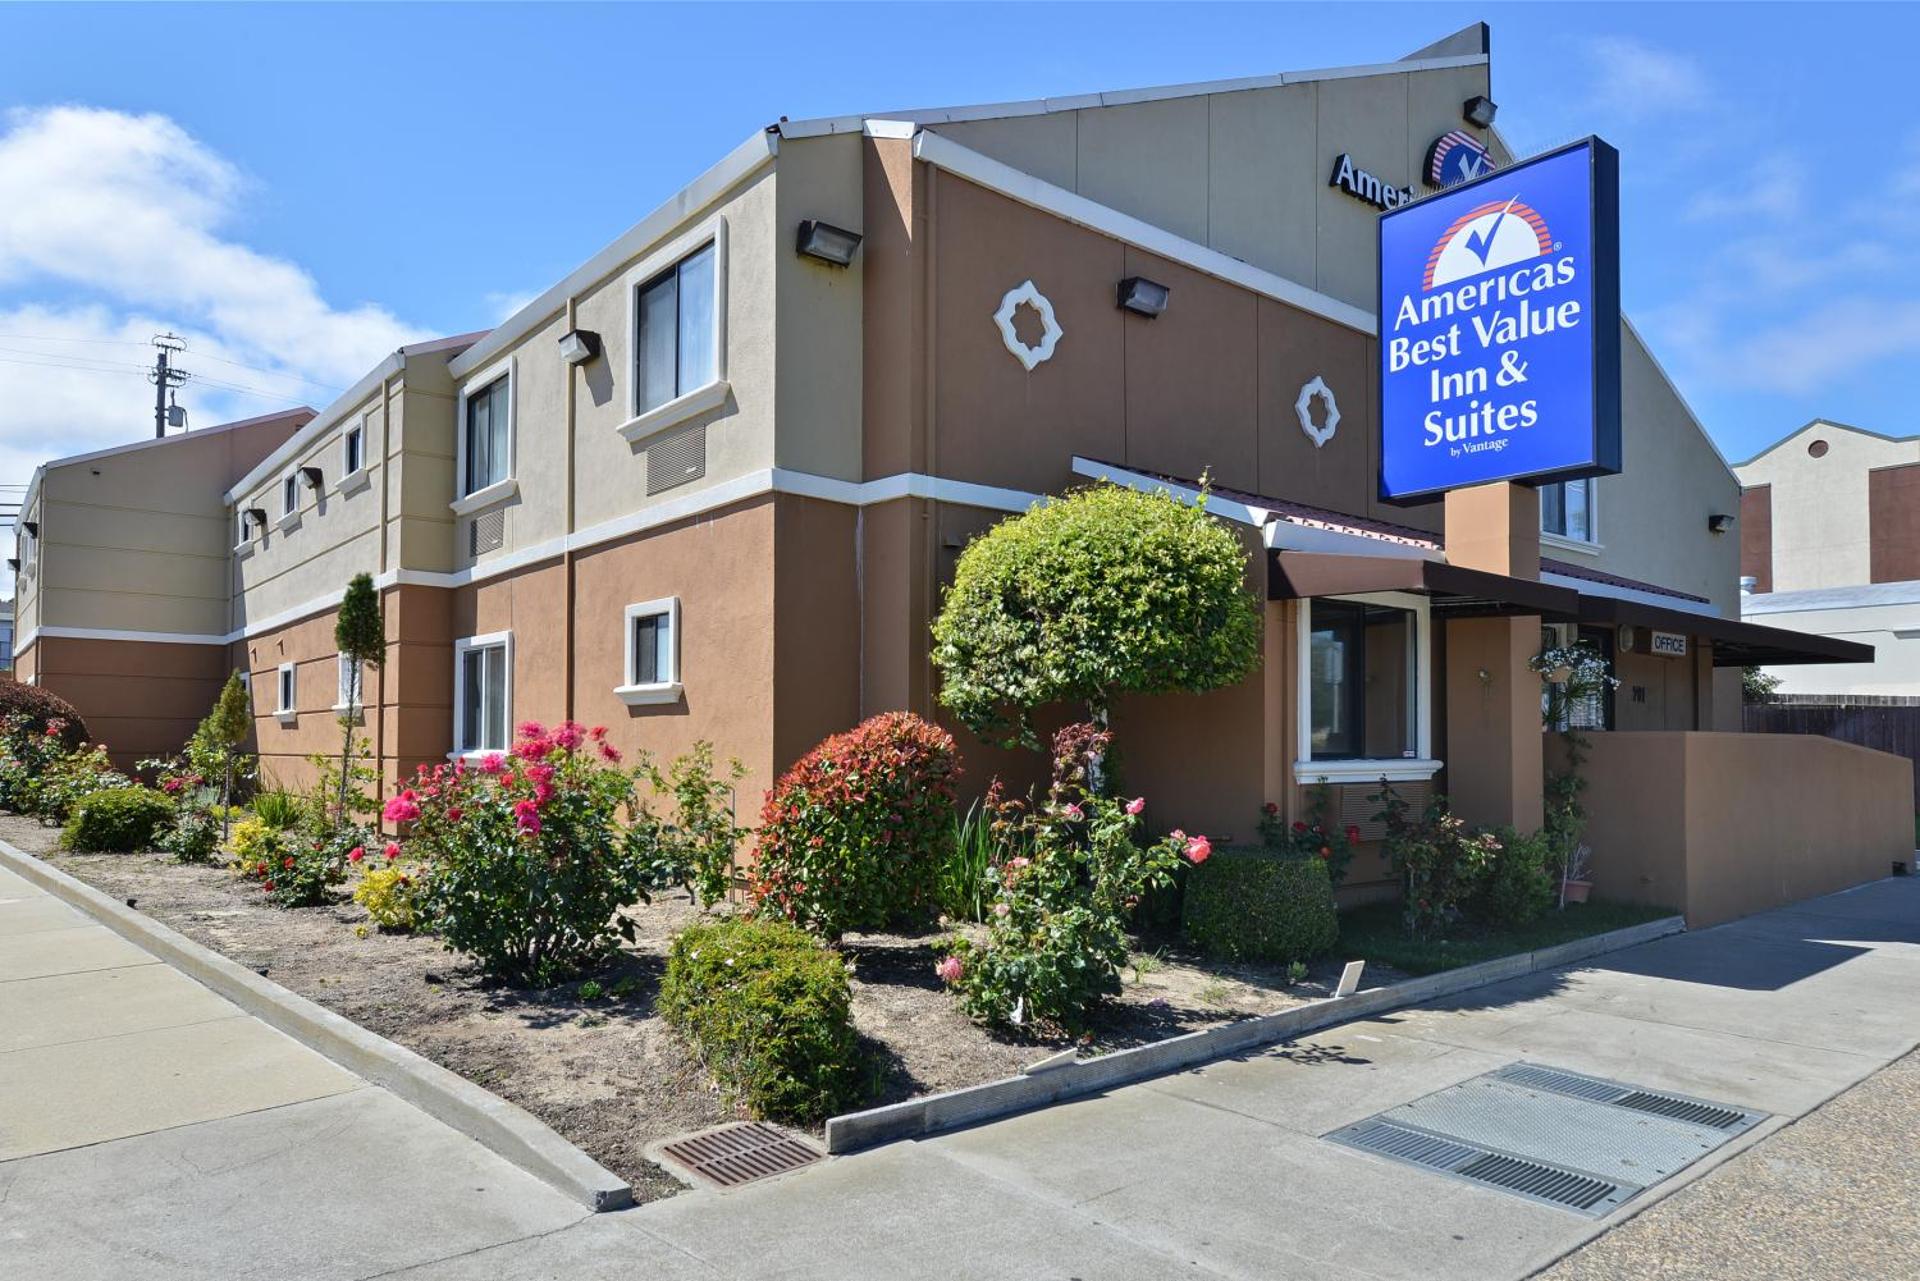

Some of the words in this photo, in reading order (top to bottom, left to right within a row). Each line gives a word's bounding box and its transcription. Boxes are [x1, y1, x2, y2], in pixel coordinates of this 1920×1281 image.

[1394, 256, 1575, 331] Americas
[1389, 324, 1461, 372] Best
[1471, 299, 1580, 348] Value
[1431, 367, 1487, 403] Inn
[1495, 350, 1528, 387] &
[1424, 399, 1538, 447] Suites
[1450, 447, 1462, 458] by
[1462, 438, 1509, 453] Vantage
[1654, 635, 1684, 652] OFFICE
